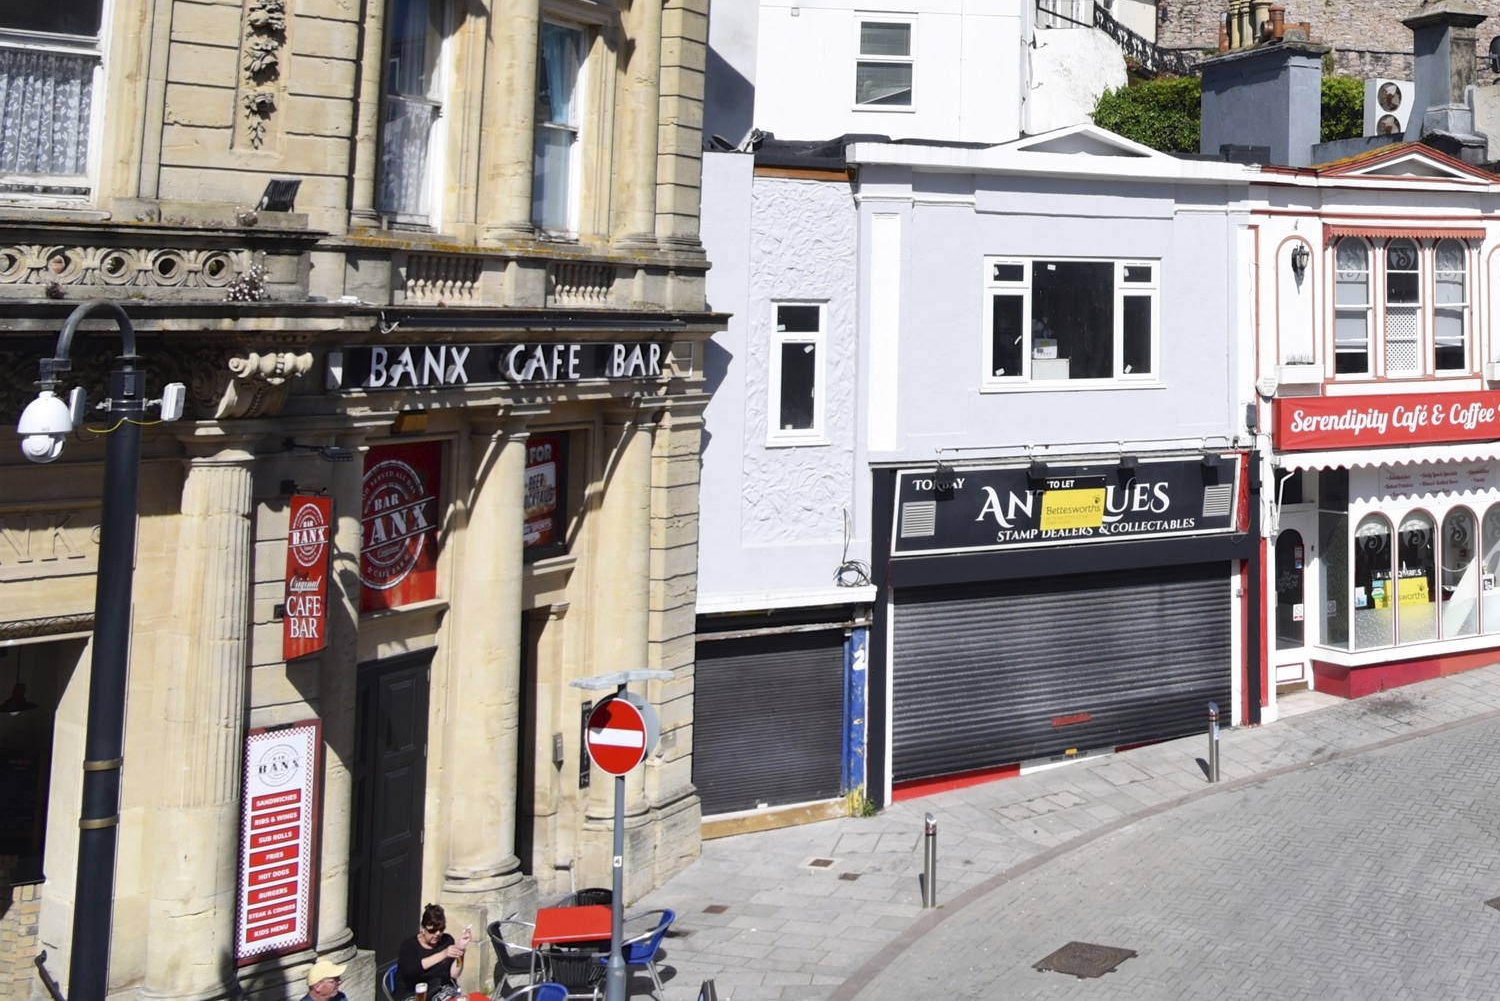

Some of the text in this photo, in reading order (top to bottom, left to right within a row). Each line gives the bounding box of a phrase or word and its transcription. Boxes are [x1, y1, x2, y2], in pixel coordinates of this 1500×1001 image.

[369, 343, 661, 388] BANX CAFE BAR
[1290, 408, 1388, 435] Serendipity
[1391, 404, 1428, 433] Café
[1431, 403, 1446, 425] &
[1449, 401, 1495, 430] Coffee
[529, 444, 552, 463] FOR
[1049, 480, 1075, 488] TO LET
[374, 493, 399, 511] BAR
[975, 481, 1170, 528] ANUES
[1046, 504, 1101, 515] Bettesworths
[303, 520, 314, 528] BAR
[361, 502, 428, 548] ANX
[997, 517, 1195, 542] STAMP DEALERS & COLLECTABLES
[293, 528, 325, 546] BANX
[289, 575, 322, 593] Original
[286, 596, 321, 616] CAFE
[290, 617, 319, 638] BAR
[852, 649, 866, 671] 2
[259, 760, 299, 774] BANX
[256, 793, 298, 807] SANDWICHES
[254, 817, 270, 826] RIBS
[277, 812, 298, 821] WINGS
[258, 831, 292, 843] SUB ROLLS
[265, 851, 284, 860] FRIES
[258, 868, 290, 881] HOT DOGS
[258, 887, 288, 899] BURGERS
[248, 910, 266, 919] STEAK
[272, 903, 296, 914] COMBOS
[253, 923, 289, 938] KIDS MENU
